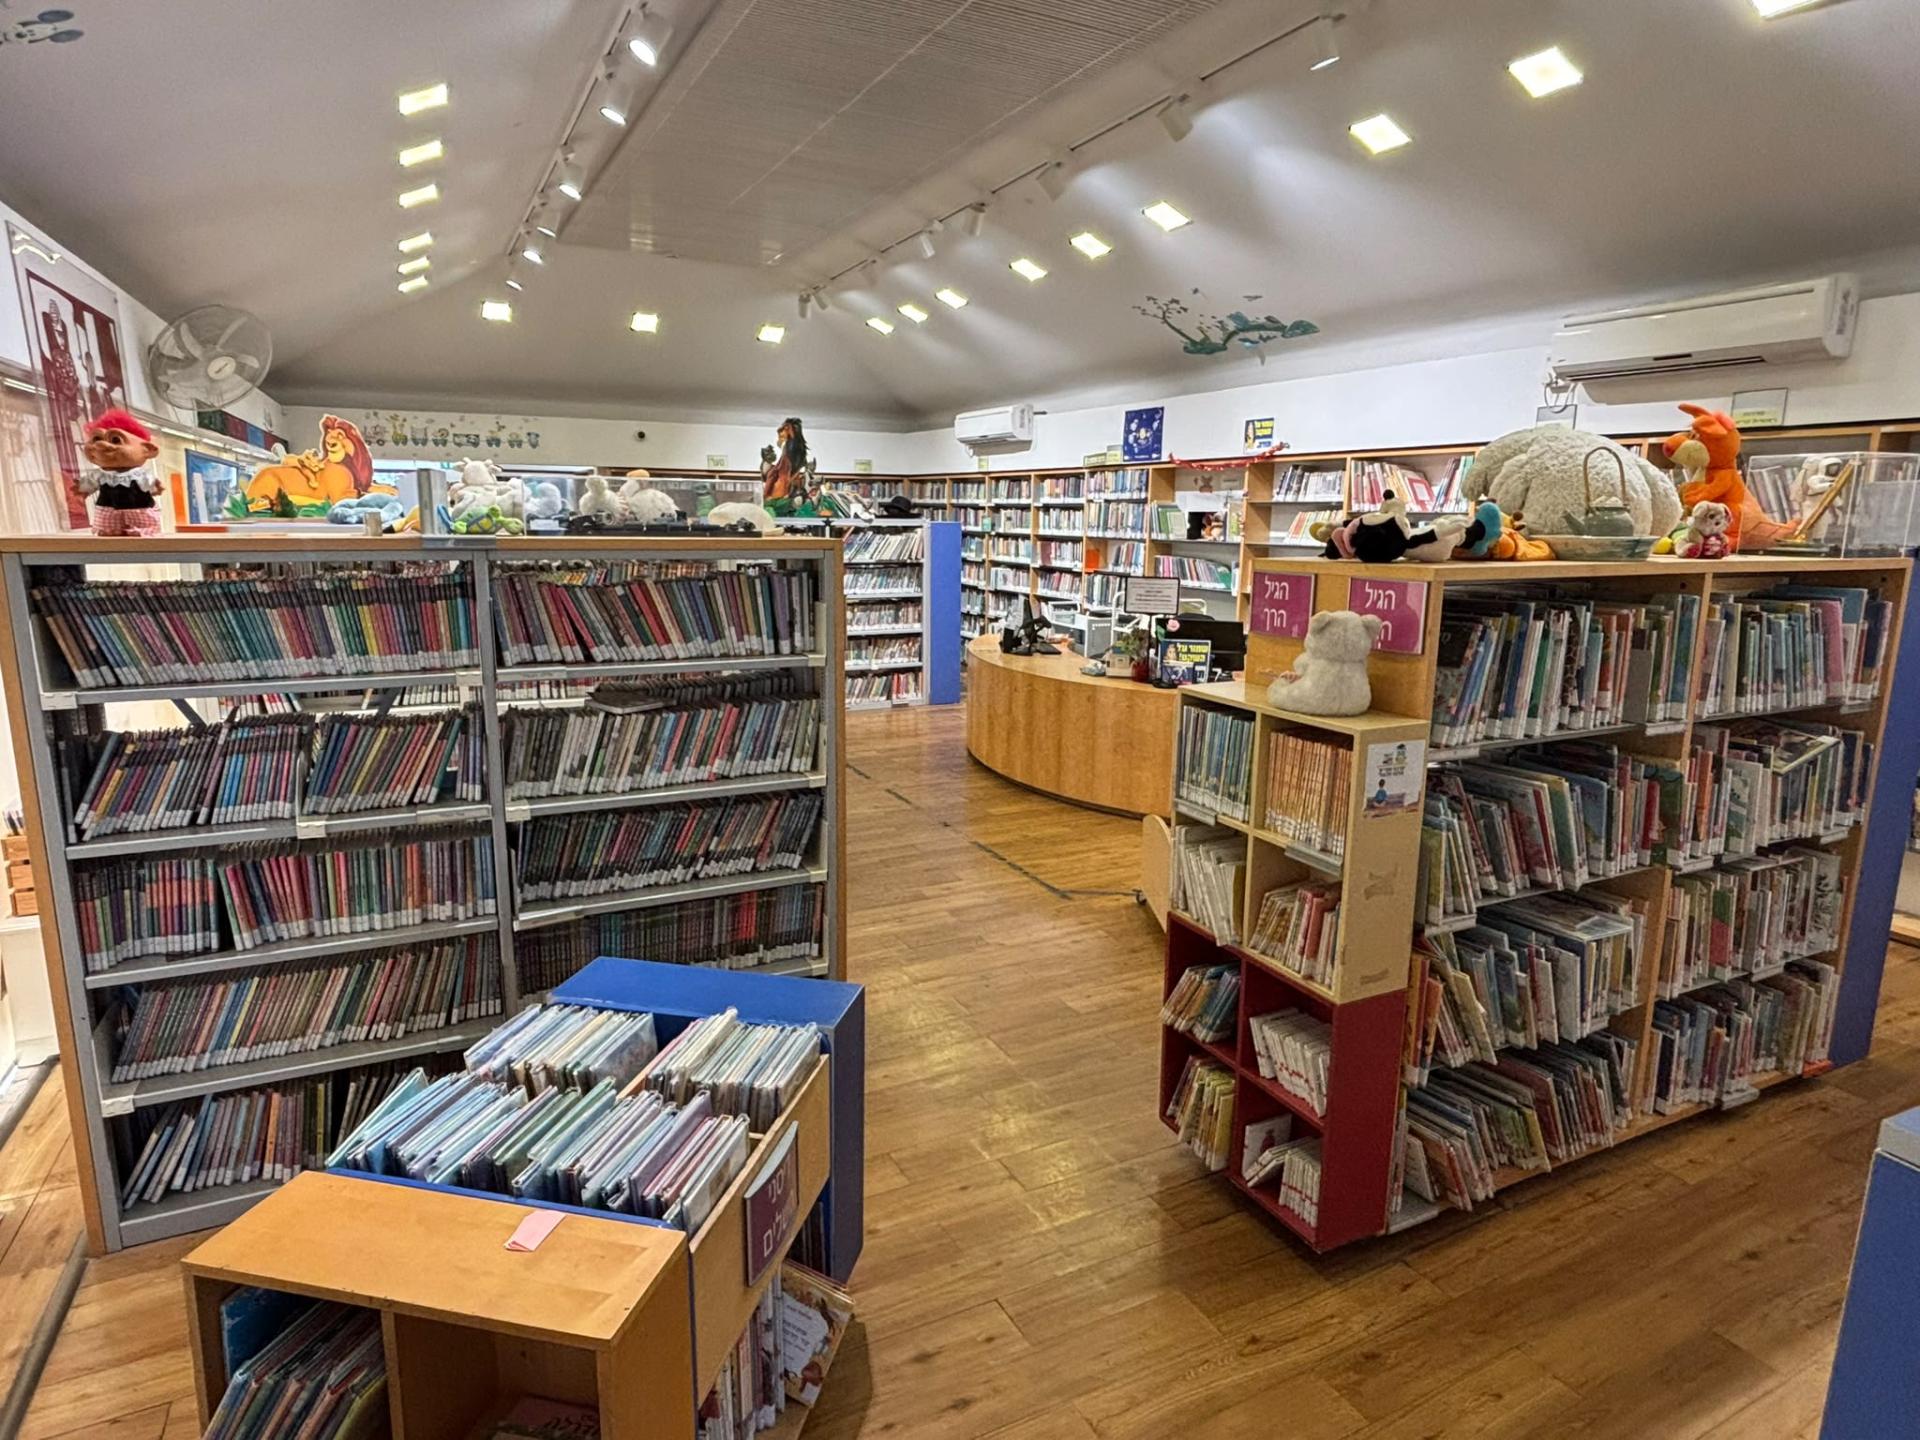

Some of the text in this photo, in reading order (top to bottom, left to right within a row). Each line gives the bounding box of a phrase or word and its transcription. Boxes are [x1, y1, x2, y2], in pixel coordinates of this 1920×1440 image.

[1264, 575, 1290, 601] הגיל
[1364, 581, 1396, 611] הגיל
[1263, 607, 1287, 631] הרך
